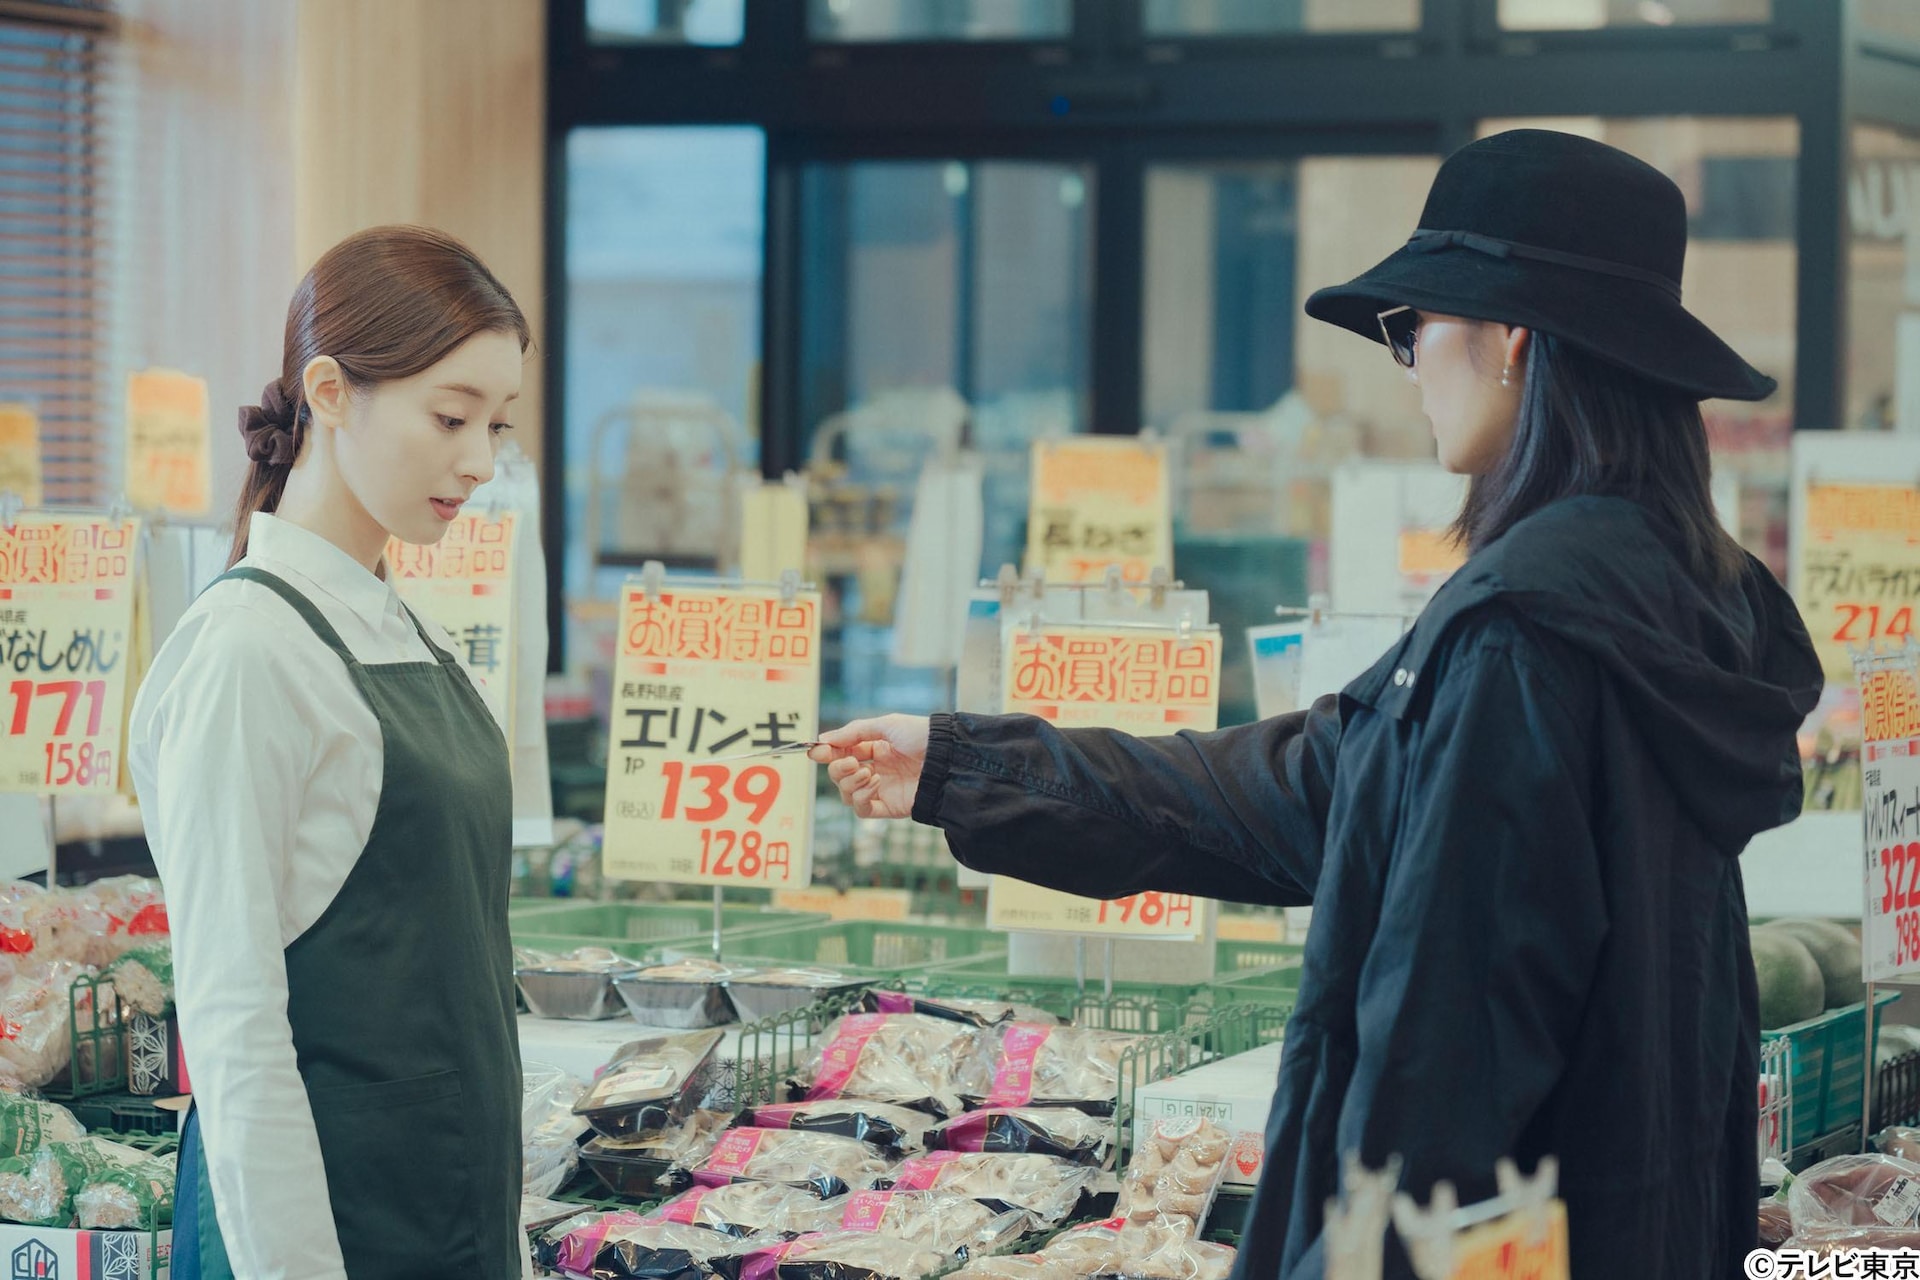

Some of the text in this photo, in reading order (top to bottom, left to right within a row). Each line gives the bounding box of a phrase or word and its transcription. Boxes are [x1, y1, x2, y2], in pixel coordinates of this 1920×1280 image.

[392, 521, 505, 574] 買得品
[629, 598, 810, 660] お買得品
[1833, 603, 1912, 641] 214
[0, 629, 120, 673] なしめじ
[1015, 640, 1210, 702] お買得品
[10, 680, 106, 736] 171
[620, 707, 808, 757] エリンギ
[45, 742, 112, 786] 158円
[625, 756, 645, 774] 1P
[661, 761, 781, 825] 139
[700, 828, 790, 880] 128円
[1881, 842, 1920, 914] 322
